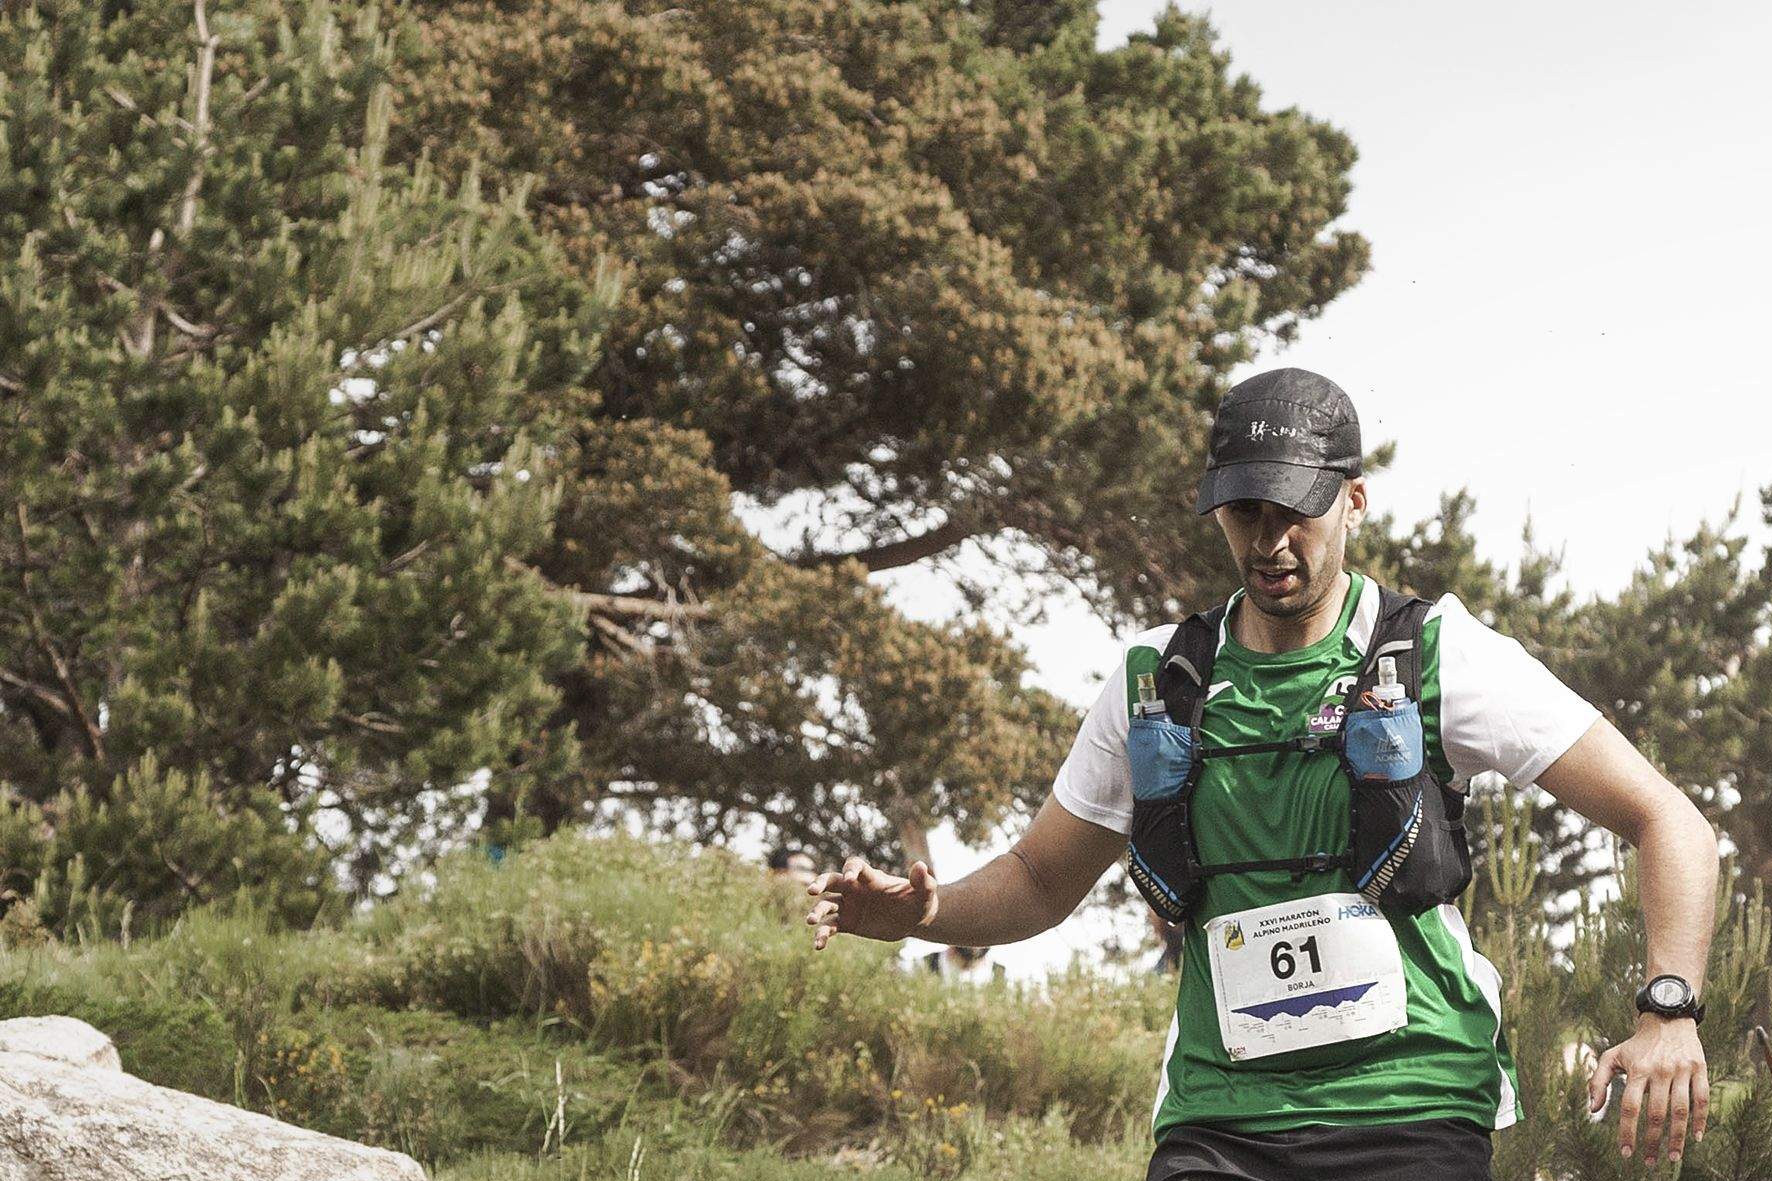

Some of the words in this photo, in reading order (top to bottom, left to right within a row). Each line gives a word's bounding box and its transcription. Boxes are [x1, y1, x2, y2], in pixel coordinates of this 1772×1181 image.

[1338, 904, 1379, 920] HOKA
[1252, 926, 1281, 939] ALPINO
[1270, 935, 1322, 980] 61
